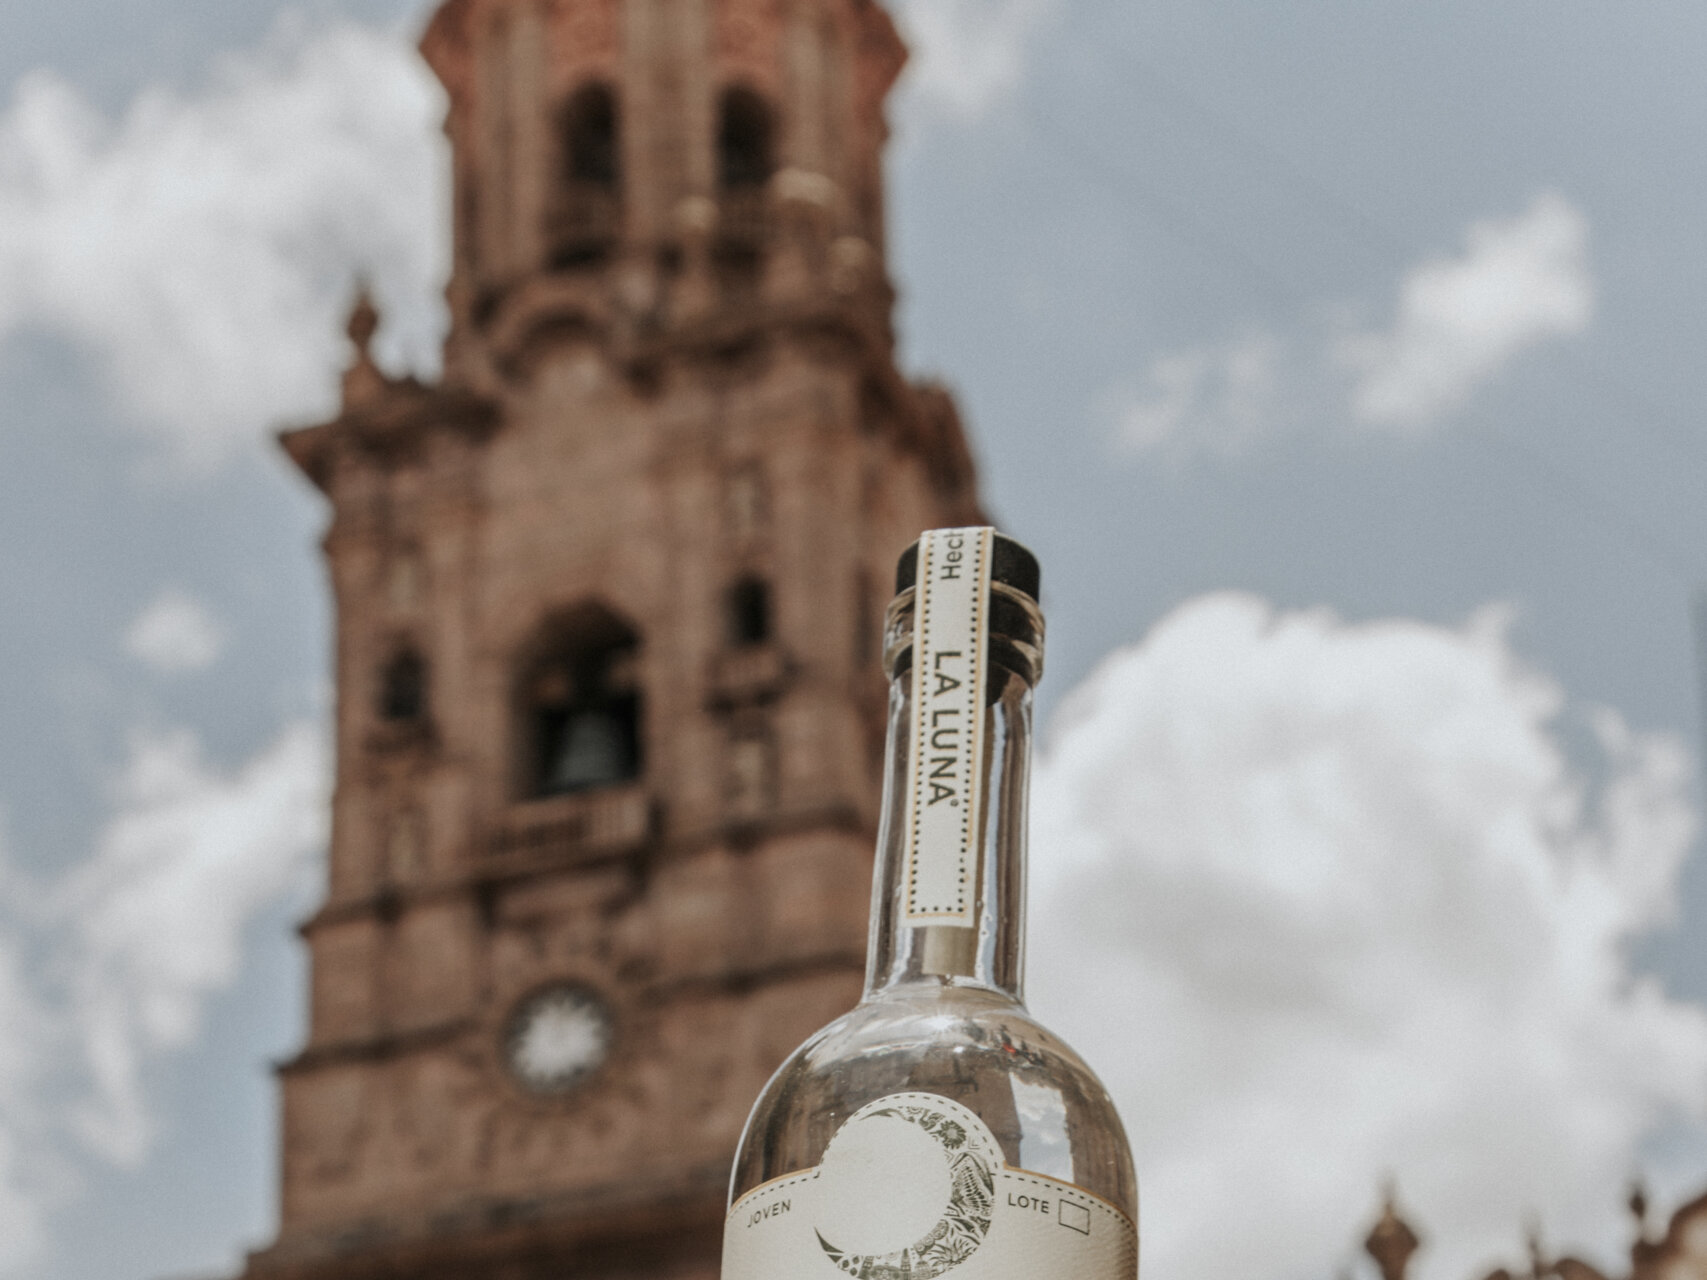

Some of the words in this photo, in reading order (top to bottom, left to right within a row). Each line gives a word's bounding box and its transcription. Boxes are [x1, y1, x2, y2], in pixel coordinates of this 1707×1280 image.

[933, 651, 962, 696] LA
[747, 1199, 792, 1228] JOVEN
[1007, 1192, 1050, 1214] LOTE
